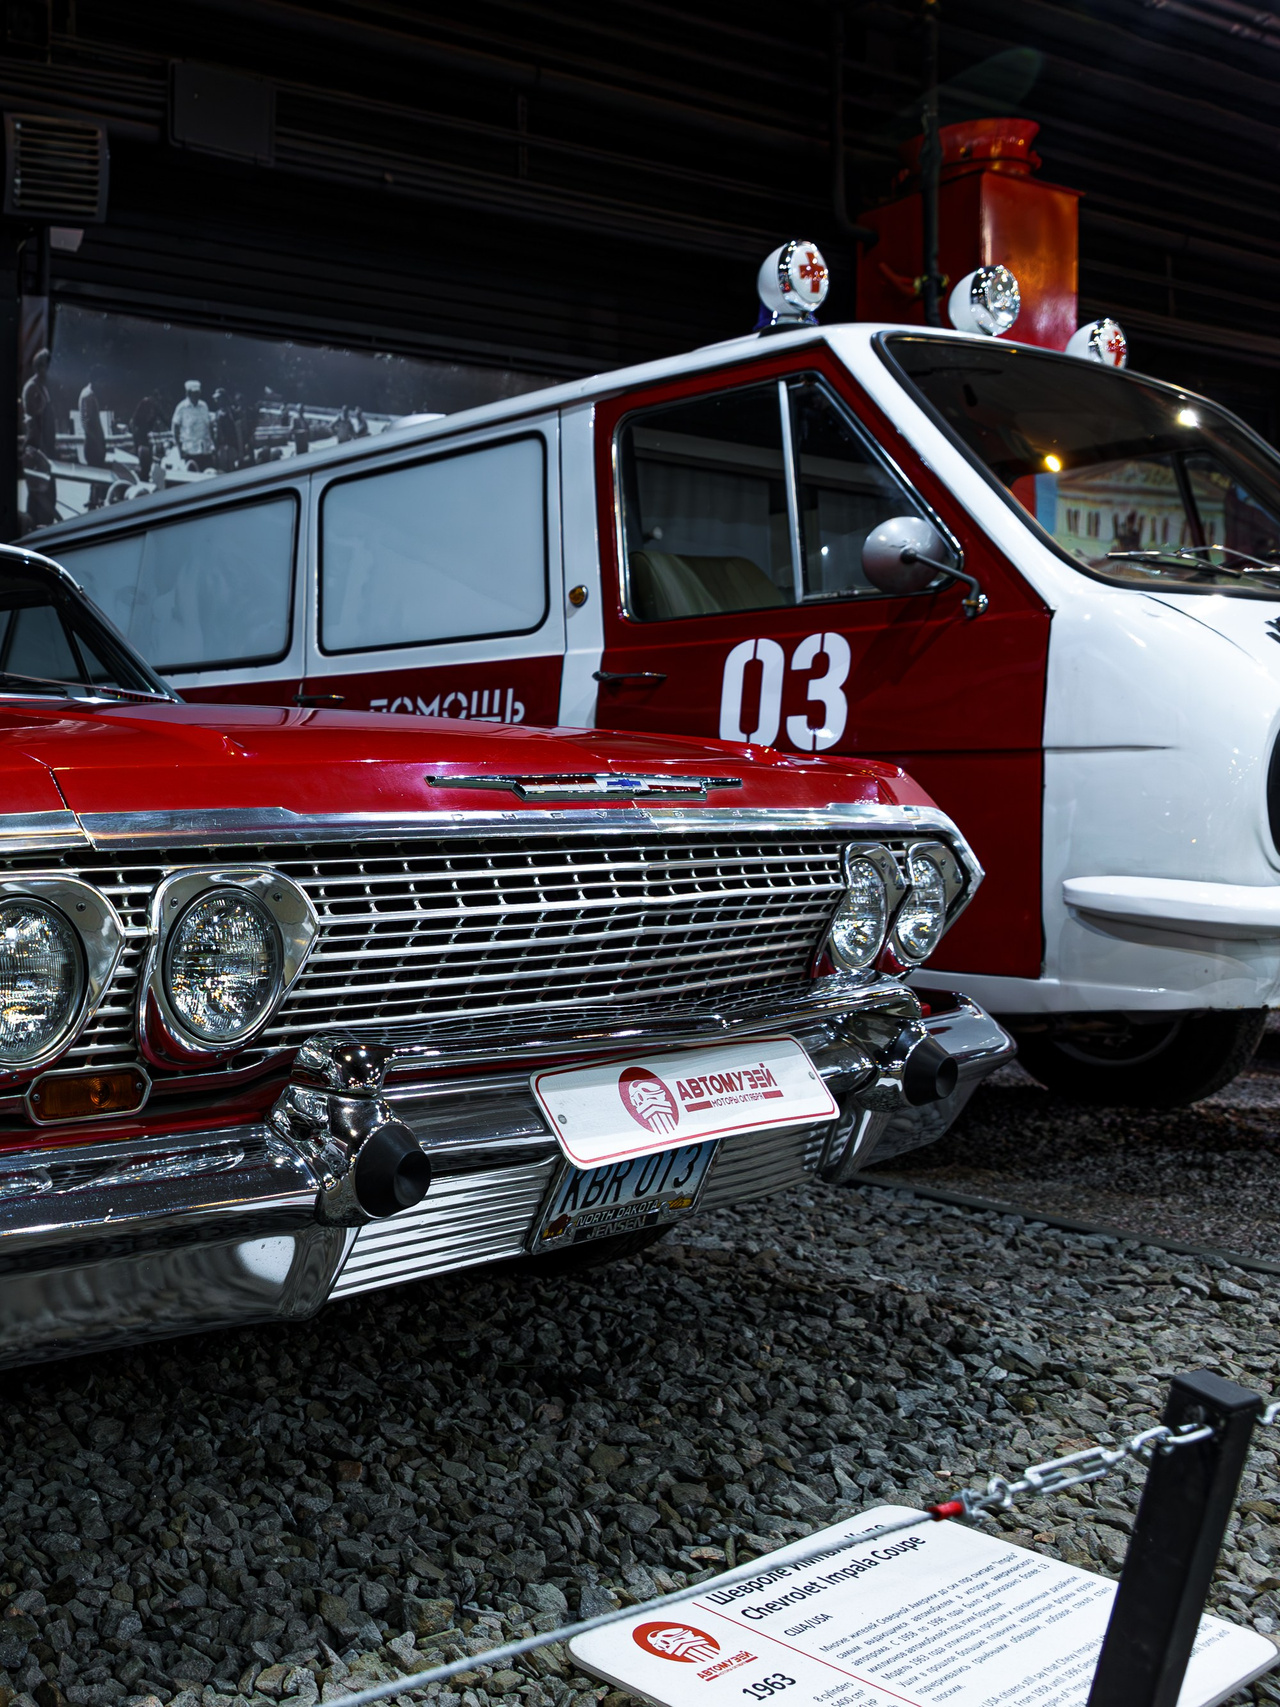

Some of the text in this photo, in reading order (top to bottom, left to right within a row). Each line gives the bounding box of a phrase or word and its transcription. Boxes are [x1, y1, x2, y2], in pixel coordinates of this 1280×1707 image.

[719, 632, 851, 751] 03
[676, 1063, 778, 1101] АВТОМУЗЕЙ
[711, 1092, 763, 1108] МОТОРЫ ОКТЯБРЯ
[559, 1142, 703, 1213] KBR 013
[577, 1199, 659, 1227] NORTH DAKOTA
[587, 1215, 647, 1239] JENSEN
[705, 1566, 793, 1606] Шевроле
[741, 1581, 827, 1620] Chevrolet
[816, 1558, 881, 1586] Impala
[870, 1535, 927, 1561] Coupe
[783, 1612, 834, 1638] США/USA
[696, 1650, 753, 1679] АВТОМУЗЕЙ
[742, 1672, 797, 1702] 1963
[821, 1682, 854, 1699] cylinders
